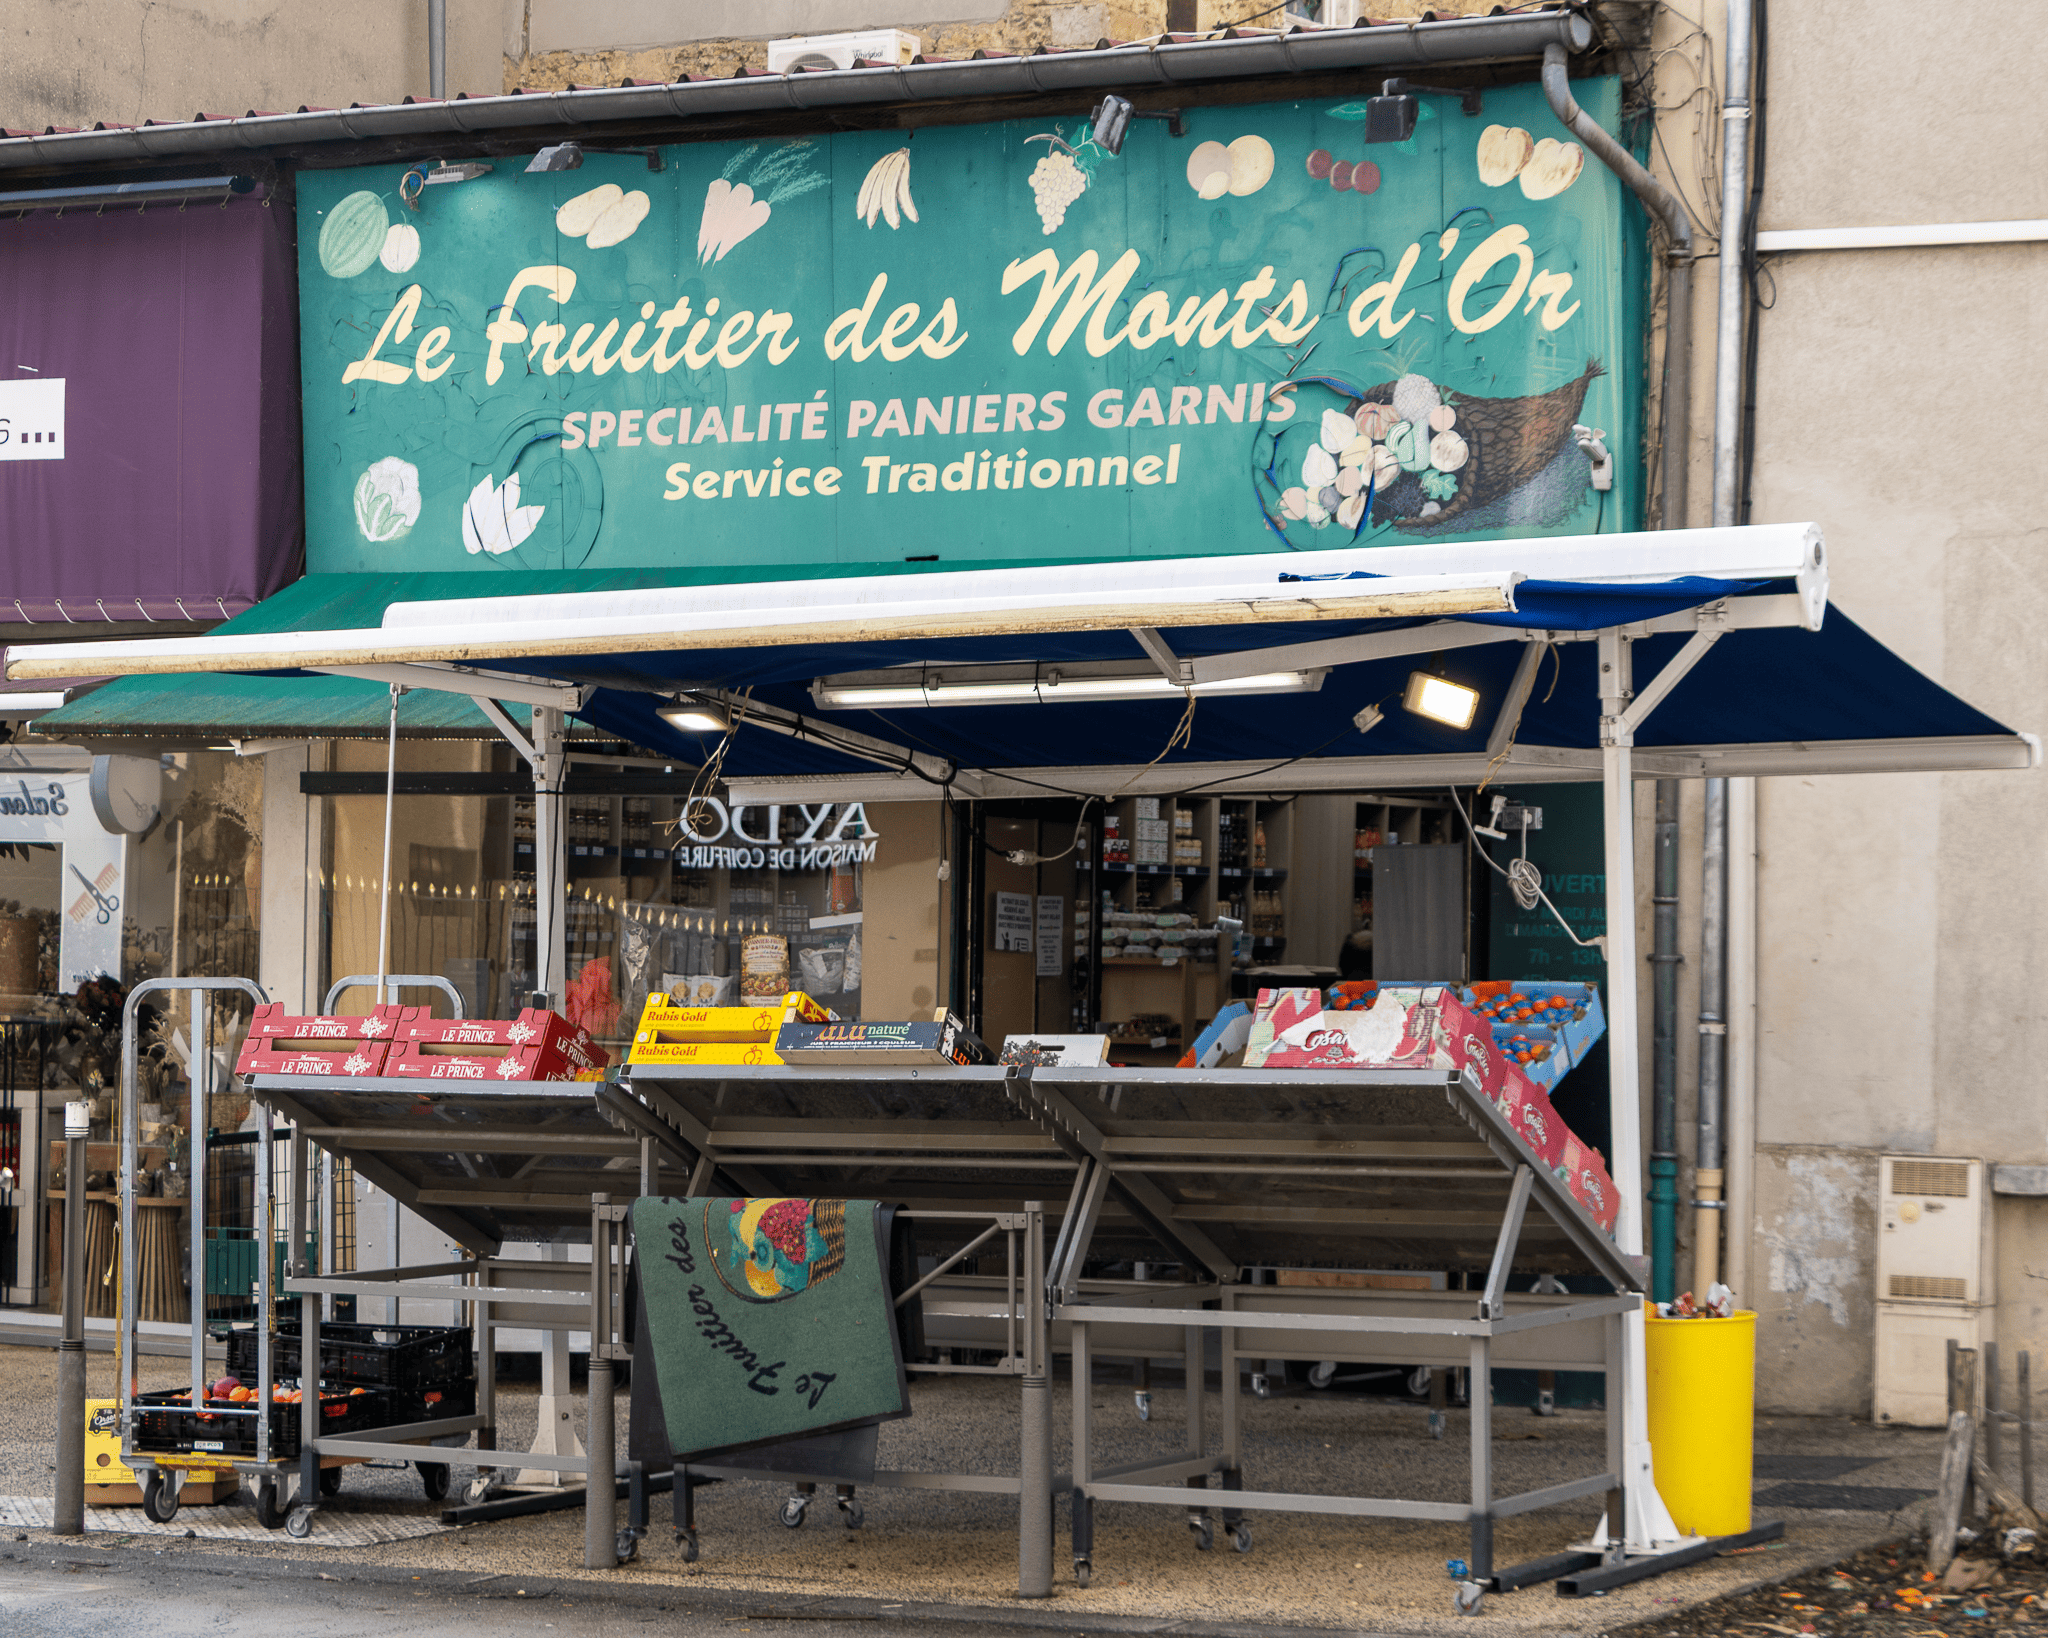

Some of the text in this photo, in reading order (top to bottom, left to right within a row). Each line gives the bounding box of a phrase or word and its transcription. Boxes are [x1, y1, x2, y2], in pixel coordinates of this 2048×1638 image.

[342, 224, 1581, 386] Le Fruitier des Monts d'Or
[560, 381, 1297, 449] SPECIALITÉ PANIERS GARNIS
[663, 443, 1181, 500] Service Traditionnel
[1541, 874, 1606, 893] UVERT
[647, 1011, 707, 1022] Rubis Gold
[294, 1026, 309, 1037] LE
[310, 1026, 348, 1037] PRINCE
[441, 1030, 455, 1042] LE
[457, 1030, 495, 1042] PRINCE
[815, 1025, 909, 1041] ULU nature
[556, 1037, 567, 1052] LE
[637, 1046, 698, 1056] Rubis Gold
[280, 1061, 295, 1073] LE
[296, 1062, 333, 1074] PRINCE
[430, 1065, 444, 1077] LE
[446, 1066, 485, 1078] PRINCE
[665, 1217, 696, 1274] des
[687, 1284, 786, 1396] Fruitier
[795, 1372, 837, 1410] Le
